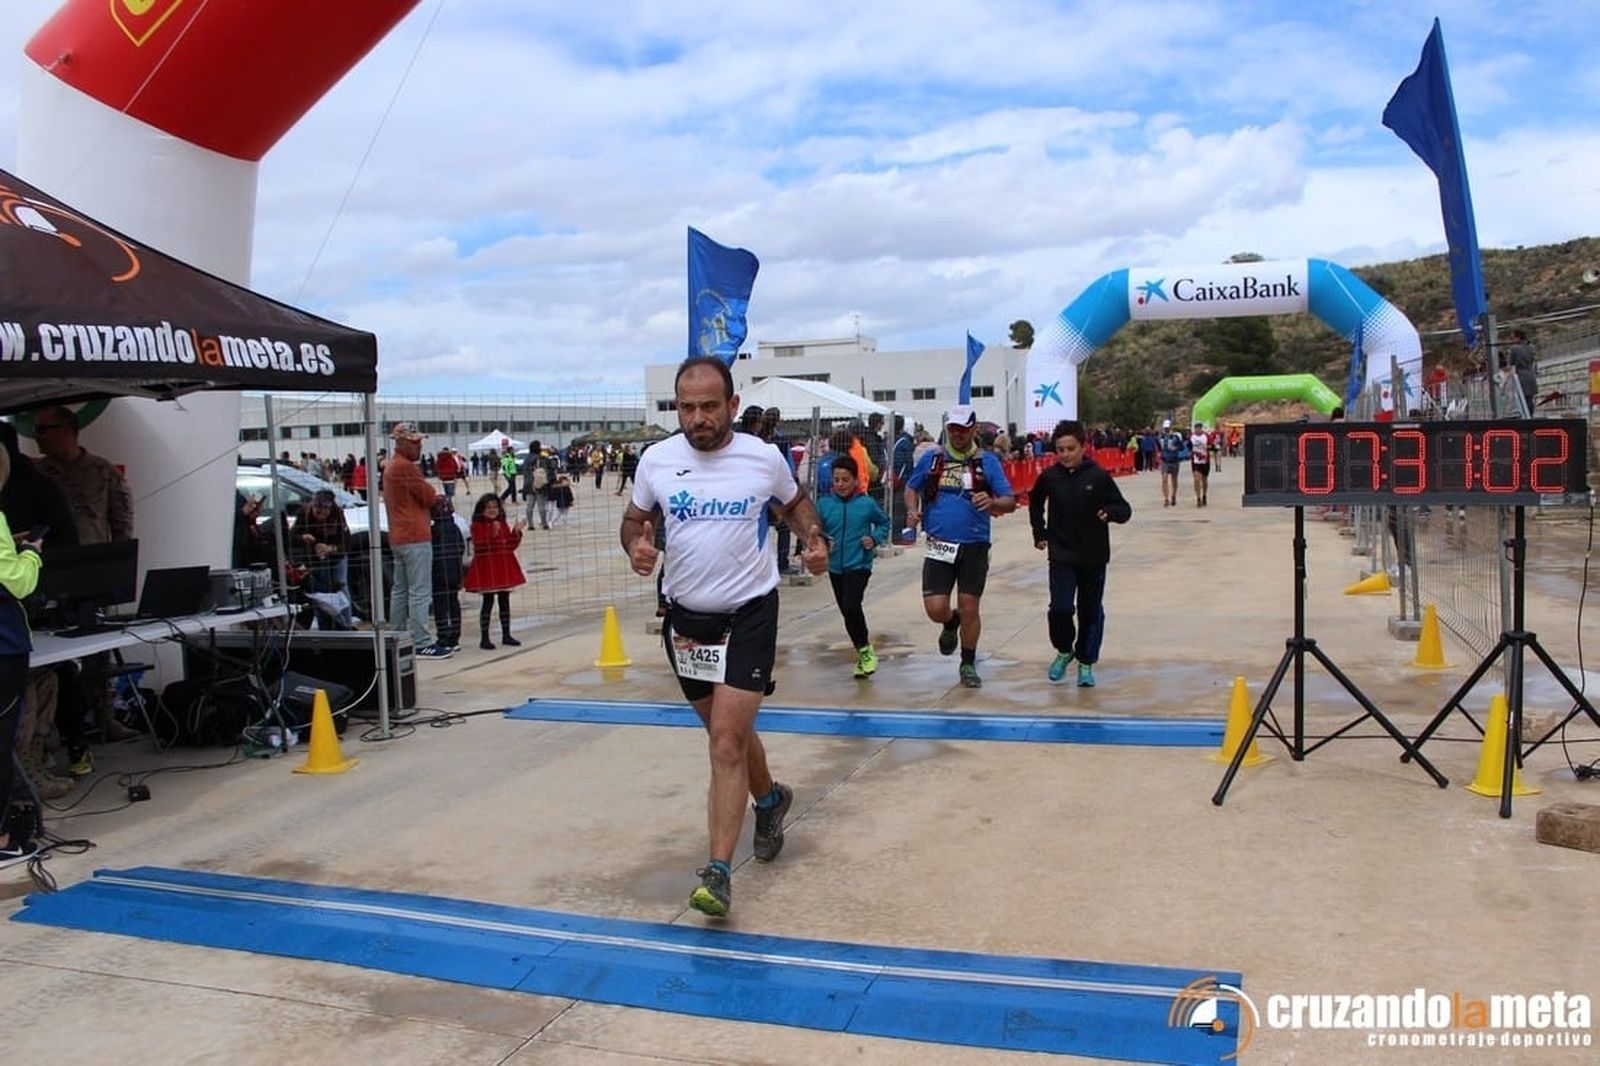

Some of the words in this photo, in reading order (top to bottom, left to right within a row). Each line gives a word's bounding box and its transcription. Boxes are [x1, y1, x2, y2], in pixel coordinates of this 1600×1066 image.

[1173, 274, 1300, 301] CaixaBank
[1299, 429, 1569, 494] 07:31:02
[688, 648, 720, 663] 2425
